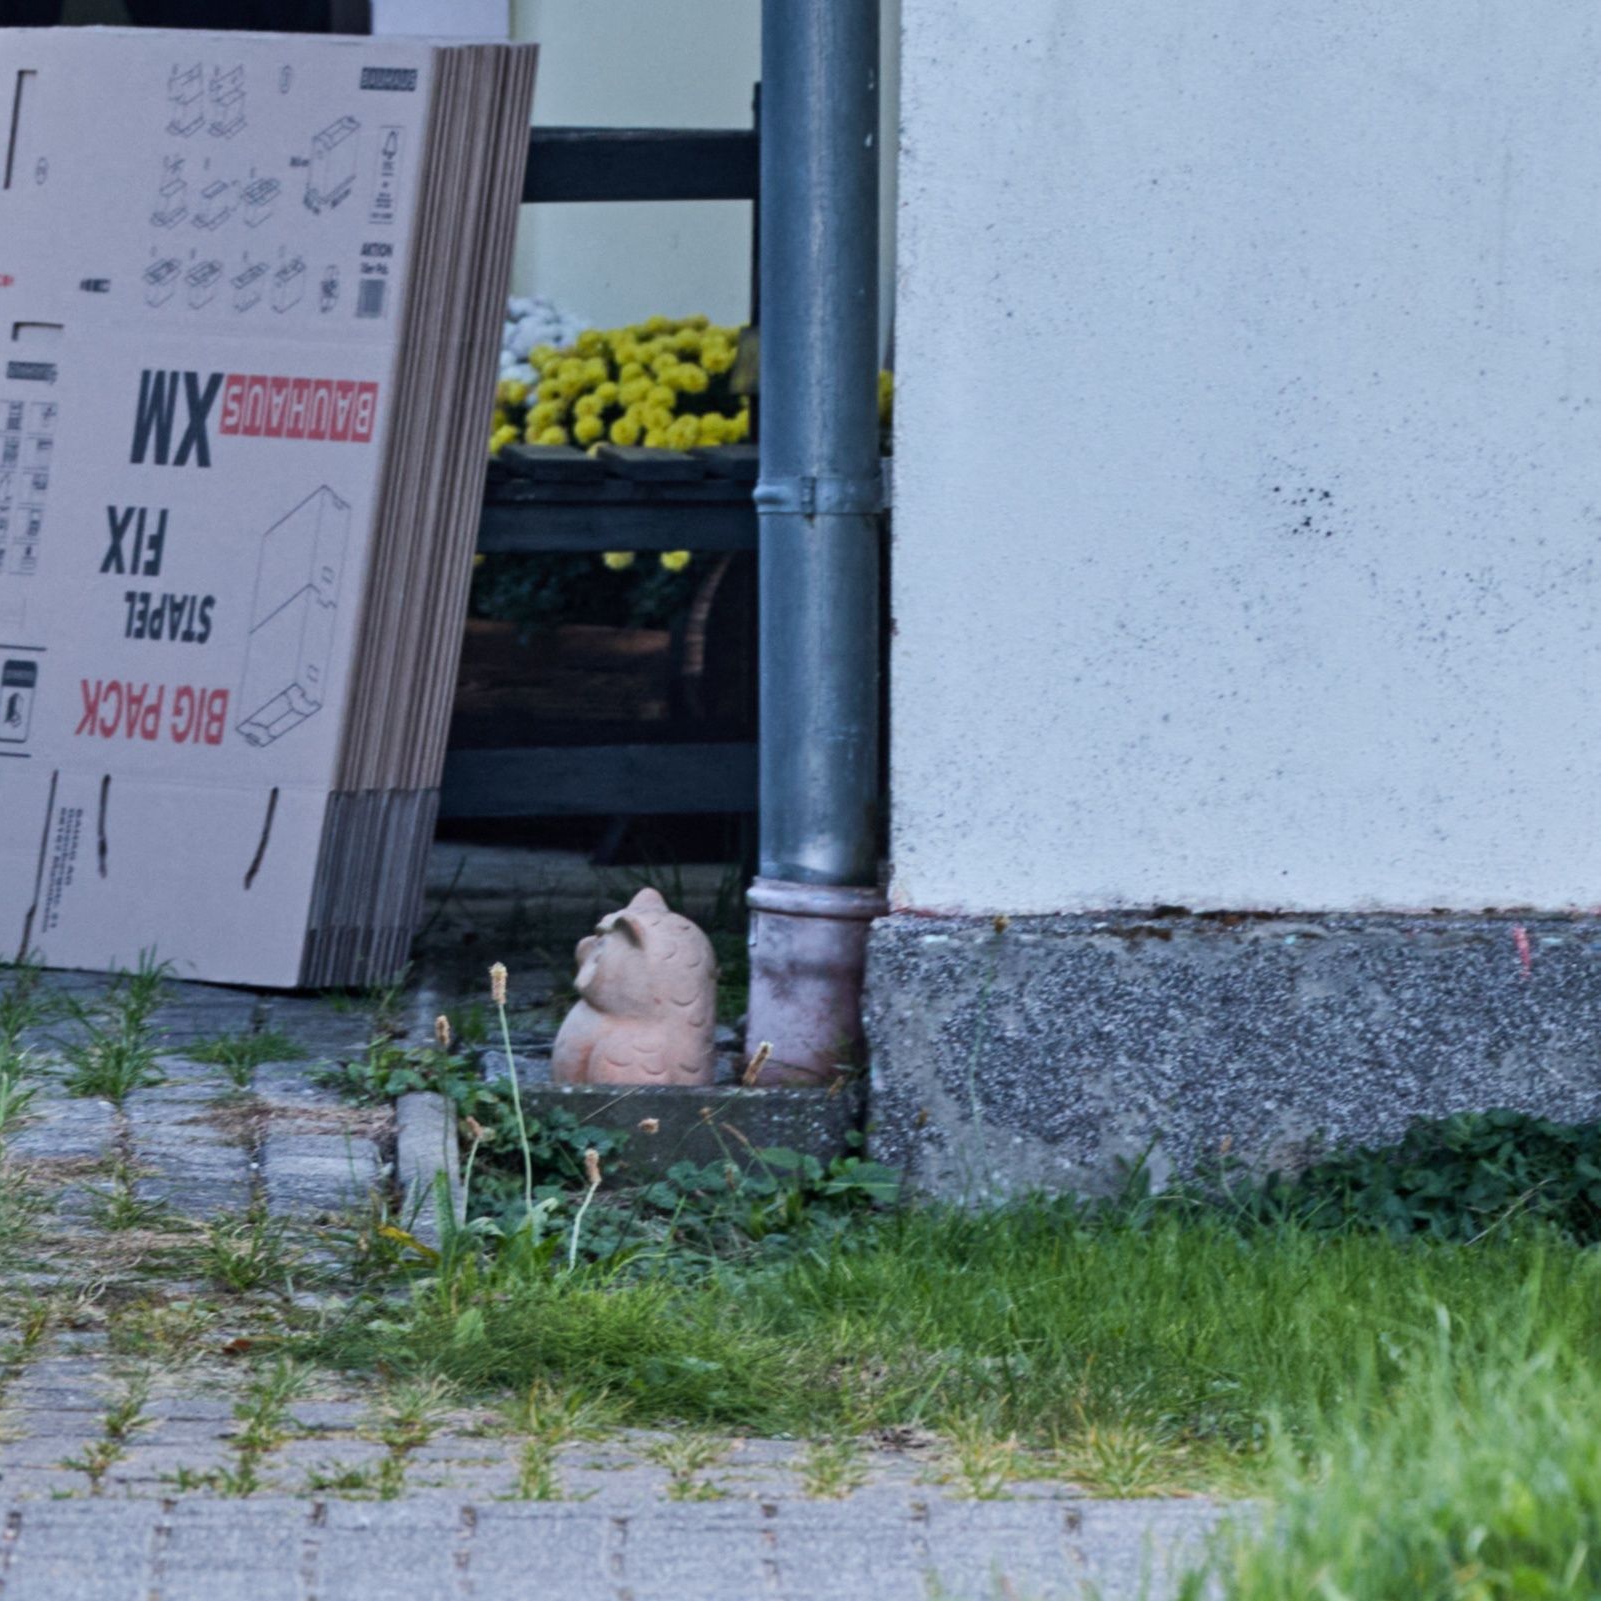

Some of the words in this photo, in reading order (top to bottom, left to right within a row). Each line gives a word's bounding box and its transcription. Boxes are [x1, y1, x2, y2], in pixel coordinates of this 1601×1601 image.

[129, 369, 225, 468] XM
[220, 376, 377, 441] BAUHAUS
[99, 505, 169, 576] FIX
[124, 590, 216, 644] STAPEL
[74, 678, 165, 741] PACK
[170, 684, 230, 746] BIG
